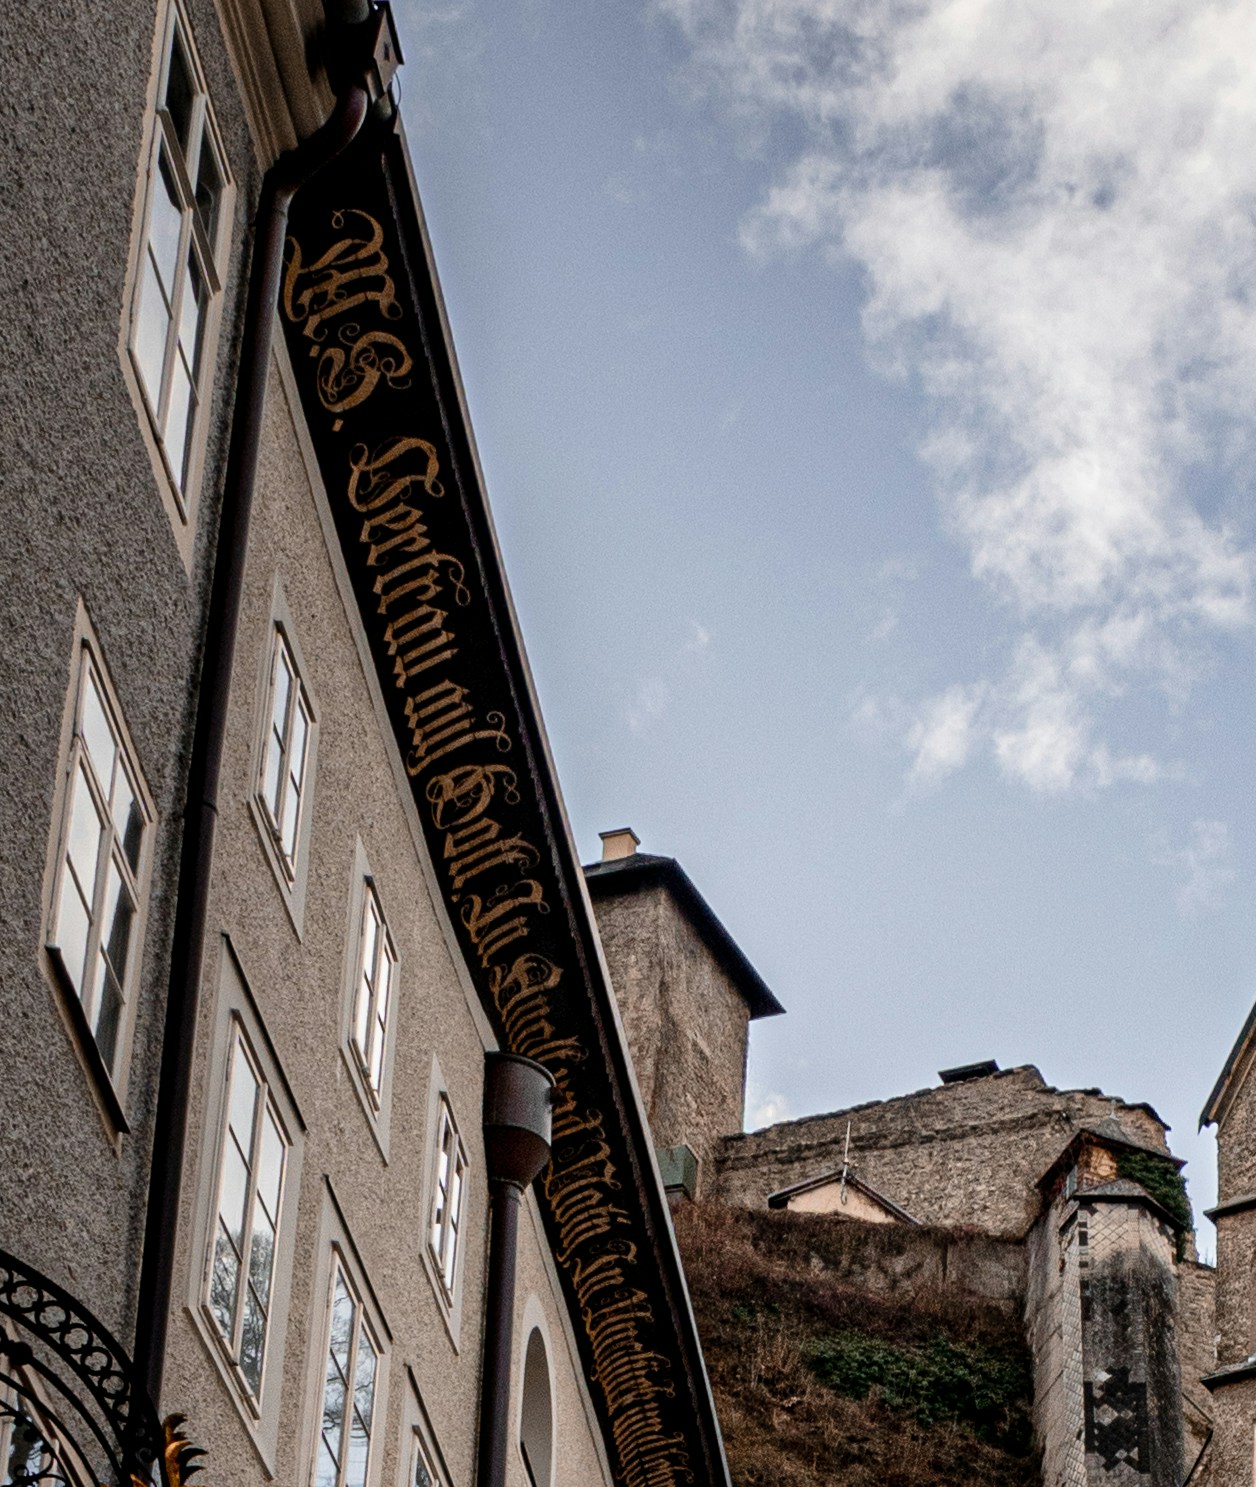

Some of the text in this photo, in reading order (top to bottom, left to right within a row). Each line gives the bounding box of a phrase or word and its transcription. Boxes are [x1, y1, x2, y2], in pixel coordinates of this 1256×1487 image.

[347, 436, 470, 688] Vertrau
[402, 678, 511, 777] auf
[426, 764, 540, 903] Gott.
